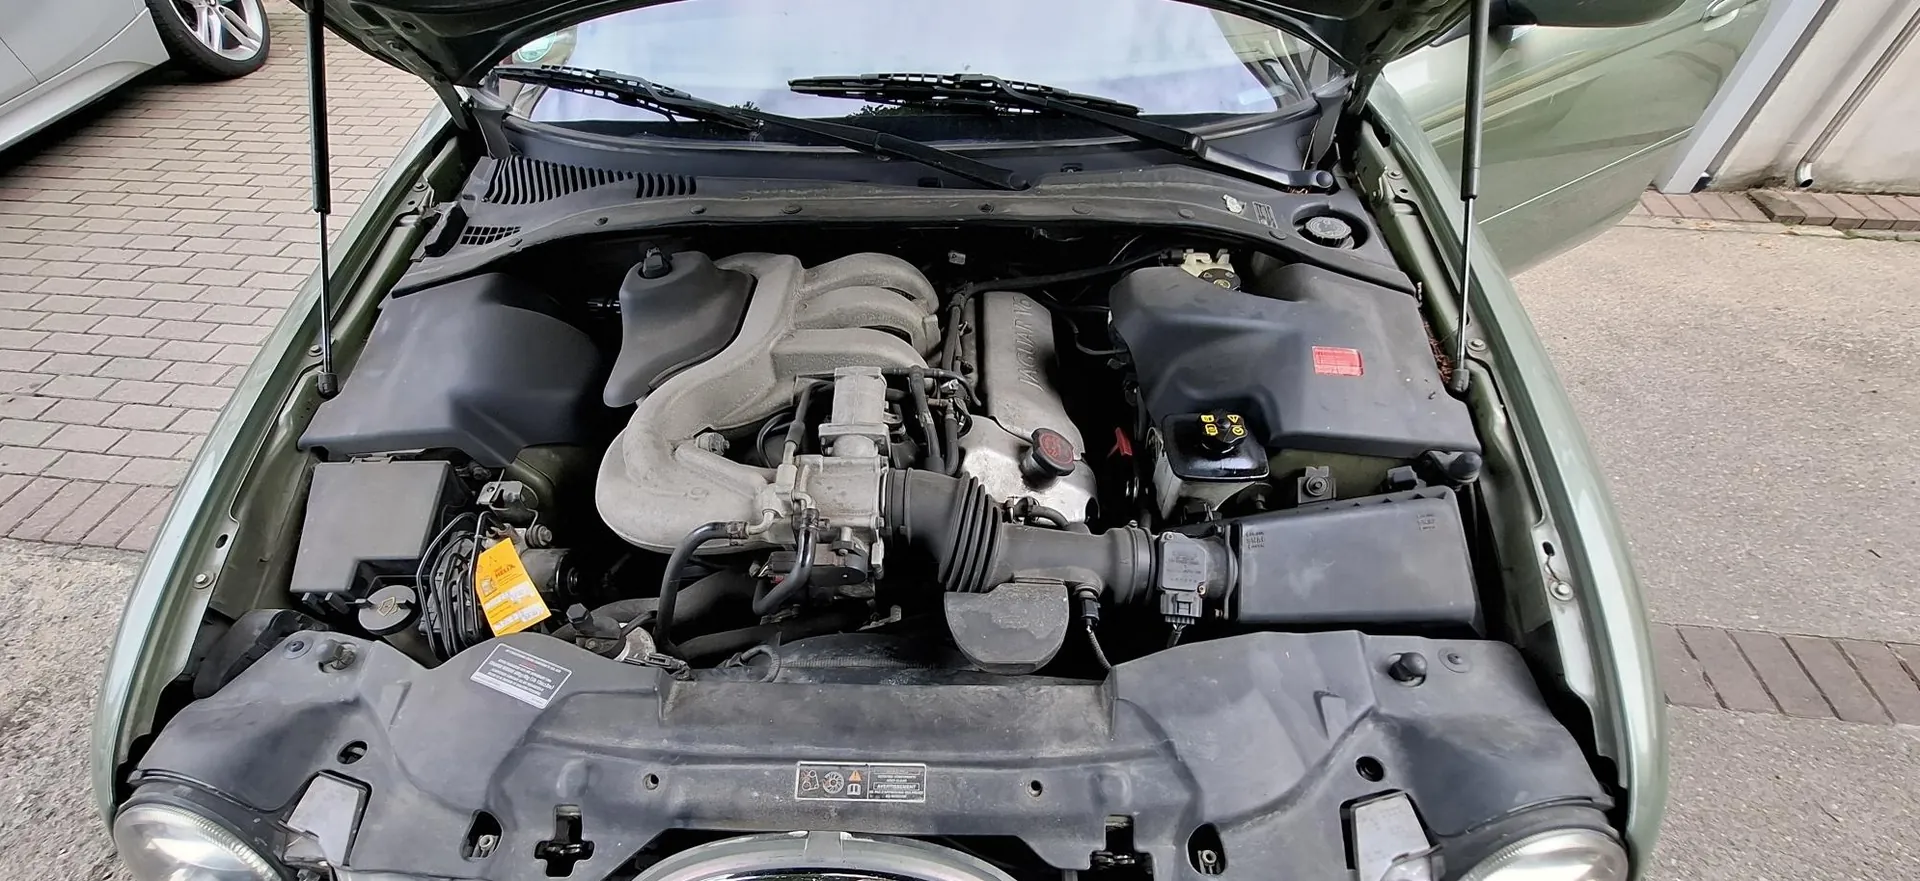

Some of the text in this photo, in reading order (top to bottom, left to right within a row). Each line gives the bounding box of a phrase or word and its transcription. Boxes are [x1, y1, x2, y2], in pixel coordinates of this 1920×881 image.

[1012, 295, 1044, 392] JAGUAR V6
[495, 564, 516, 578] HELIX
